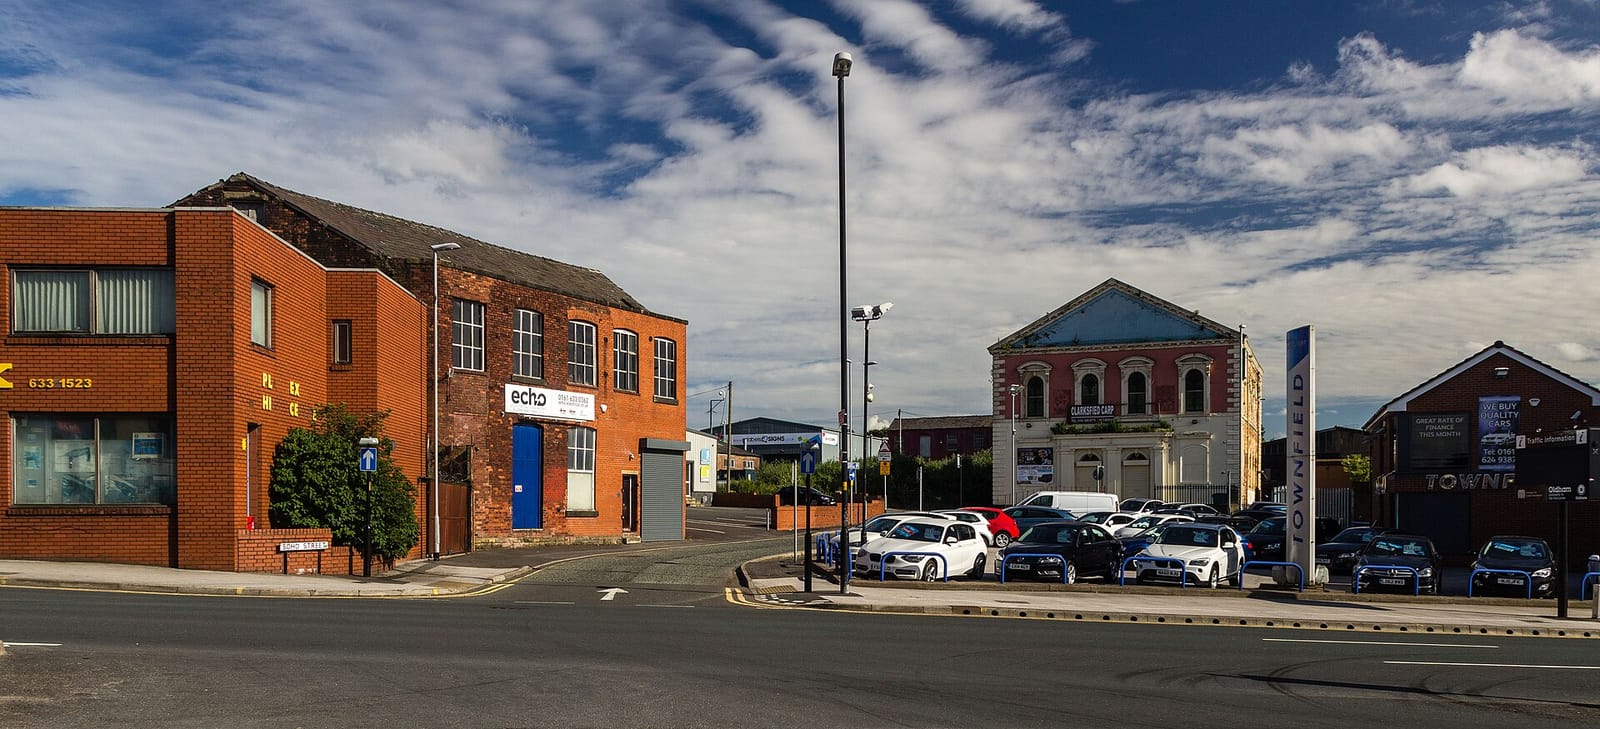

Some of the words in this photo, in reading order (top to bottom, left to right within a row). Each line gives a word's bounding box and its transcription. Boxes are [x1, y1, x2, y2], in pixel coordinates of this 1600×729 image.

[28, 378, 55, 388] 633
[59, 378, 93, 388] 1523
[511, 387, 547, 407] echo
[262, 394, 272, 411] HI
[1498, 402, 1517, 410] BUY
[1480, 411, 1519, 419] QUALITY
[1497, 448, 1516, 456] 0161
[1292, 374, 1304, 543] TOWNFIELD
[1481, 456, 1496, 464] 624
